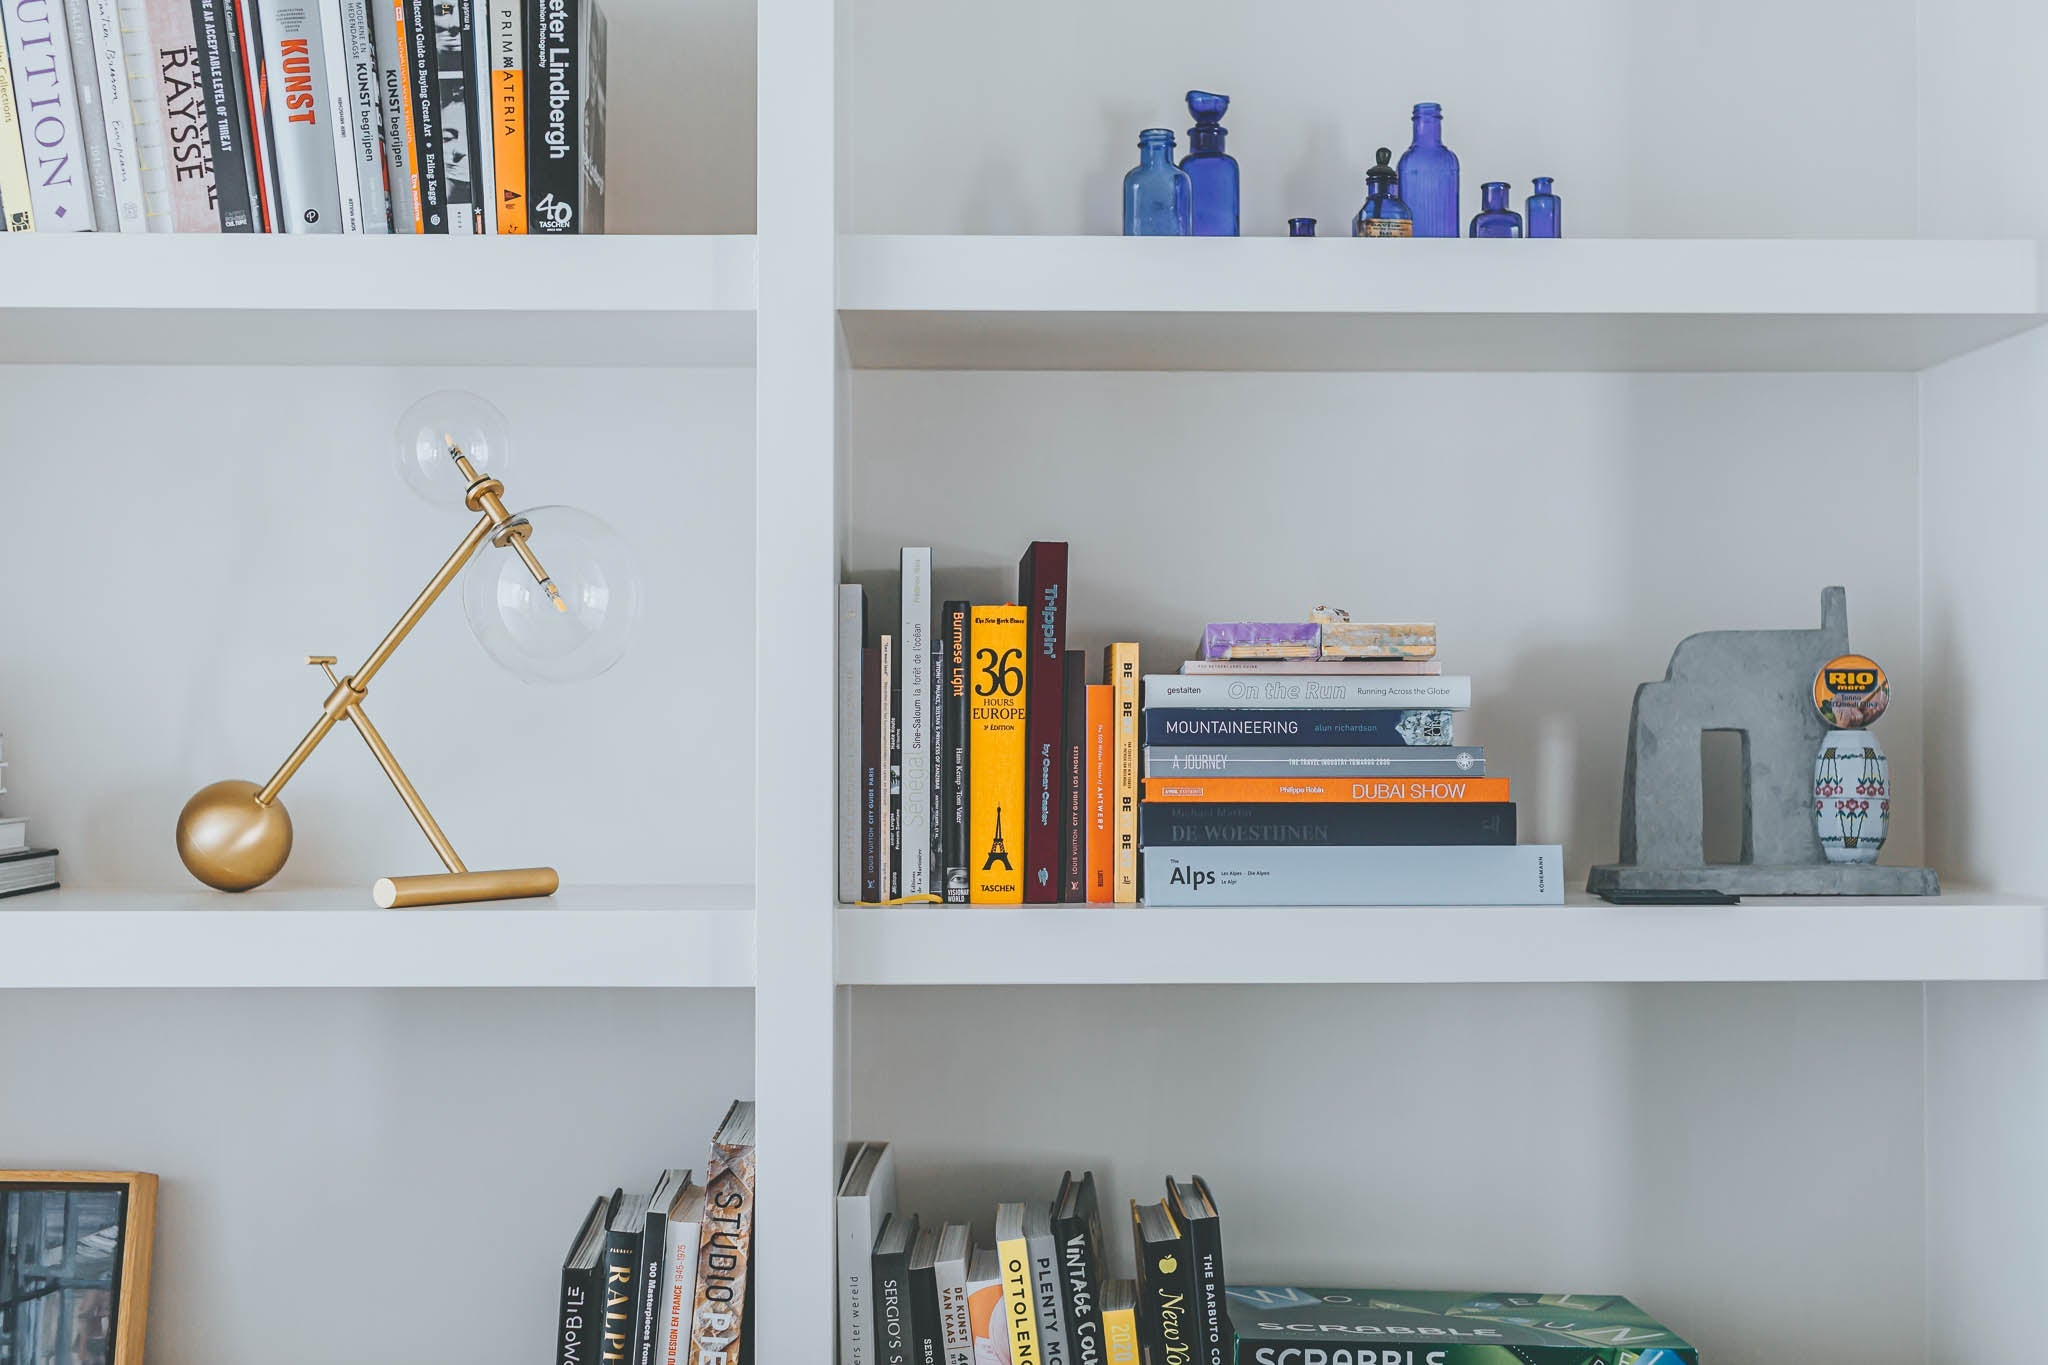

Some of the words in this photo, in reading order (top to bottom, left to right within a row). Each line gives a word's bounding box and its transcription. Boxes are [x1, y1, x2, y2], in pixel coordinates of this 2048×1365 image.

[203, 10, 214, 22] AN
[355, 1, 367, 41] MODERNE
[412, 0, 423, 33] llector's
[347, 2, 360, 60] HEDENDAAGSE
[205, 23, 221, 79] ACCEPTABLE
[360, 43, 367, 54] EN
[415, 33, 427, 59] Guide
[538, 23, 547, 68] Photography
[418, 59, 427, 69] to
[211, 79, 225, 106] LEVEL
[281, 39, 315, 125] KUNST
[356, 63, 371, 109] KUNST
[386, 69, 401, 114] KUNST
[417, 69, 430, 99] Buying
[160, 46, 204, 182] RAYSSE
[216, 106, 228, 118] OF
[421, 99, 432, 124] Great
[544, 47, 570, 159] Lindbergh
[218, 119, 232, 152] THREAT
[359, 110, 374, 162] begrijpen
[389, 116, 405, 168] begrijpen
[423, 123, 433, 137] Art
[425, 153, 436, 180] Erling
[427, 180, 438, 206] Kagge
[535, 192, 573, 223] 40
[539, 220, 571, 228] TASCHEN
[1041, 584, 1059, 659] Trippin'
[912, 623, 921, 651] l'océan
[953, 612, 965, 664] Burmese
[912, 654, 921, 664] de
[974, 648, 1024, 697] 36
[912, 667, 921, 685] forêt
[949, 667, 965, 697] Light
[1167, 686, 1201, 695] gestalten
[1228, 681, 1260, 699] On
[1265, 681, 1300, 699] the
[1305, 681, 1346, 699] Run
[1357, 687, 1387, 696] Running
[1388, 687, 1413, 695] Across
[1413, 687, 1426, 695] the
[1426, 687, 1451, 695] Globe
[1829, 672, 1874, 685] RIO
[912, 688, 921, 697] la
[983, 698, 1014, 707] HOURS
[912, 699, 921, 749] Sine-Saloum
[973, 708, 1026, 720] EUROPE
[1166, 720, 1298, 734] MOUNTAINEERING
[1334, 724, 1377, 732] richardson
[1042, 744, 1051, 758] by
[1172, 754, 1180, 769] A
[1184, 754, 1229, 769] JOURNEY
[1300, 758, 1320, 766] TRAVEL
[954, 765, 963, 785] Kemp
[1041, 758, 1051, 790] Oscar
[1352, 783, 1405, 799] DUBAI
[1410, 783, 1466, 799] SHOW
[1172, 825, 1198, 841] DE
[1170, 866, 1216, 890] Alps
[705, 1191, 743, 1303] STUDIO
[649, 1261, 658, 1278] 100
[674, 1244, 687, 1282] 1945-1975
[1203, 1253, 1214, 1278] THE
[671, 1284, 683, 1316] FRANCE
[849, 1275, 860, 1318] wereld
[943, 1288, 953, 1311] VAN
[954, 1287, 964, 1302] DE
[1037, 1257, 1058, 1332] PLENTY
[643, 1279, 657, 1344] Masterpieces
[670, 1316, 680, 1329] EN
[884, 1279, 902, 1349] SERGIO'S
[956, 1305, 969, 1342] KUNST
[1158, 1288, 1185, 1345] New
[1205, 1284, 1220, 1343] BARBUTO
[668, 1329, 678, 1356] DESIGN
[851, 1322, 861, 1341] ter
[944, 1313, 956, 1345] KAAS
[1256, 1321, 1503, 1338] SCRABBLE
[1111, 1324, 1134, 1363] 2020
